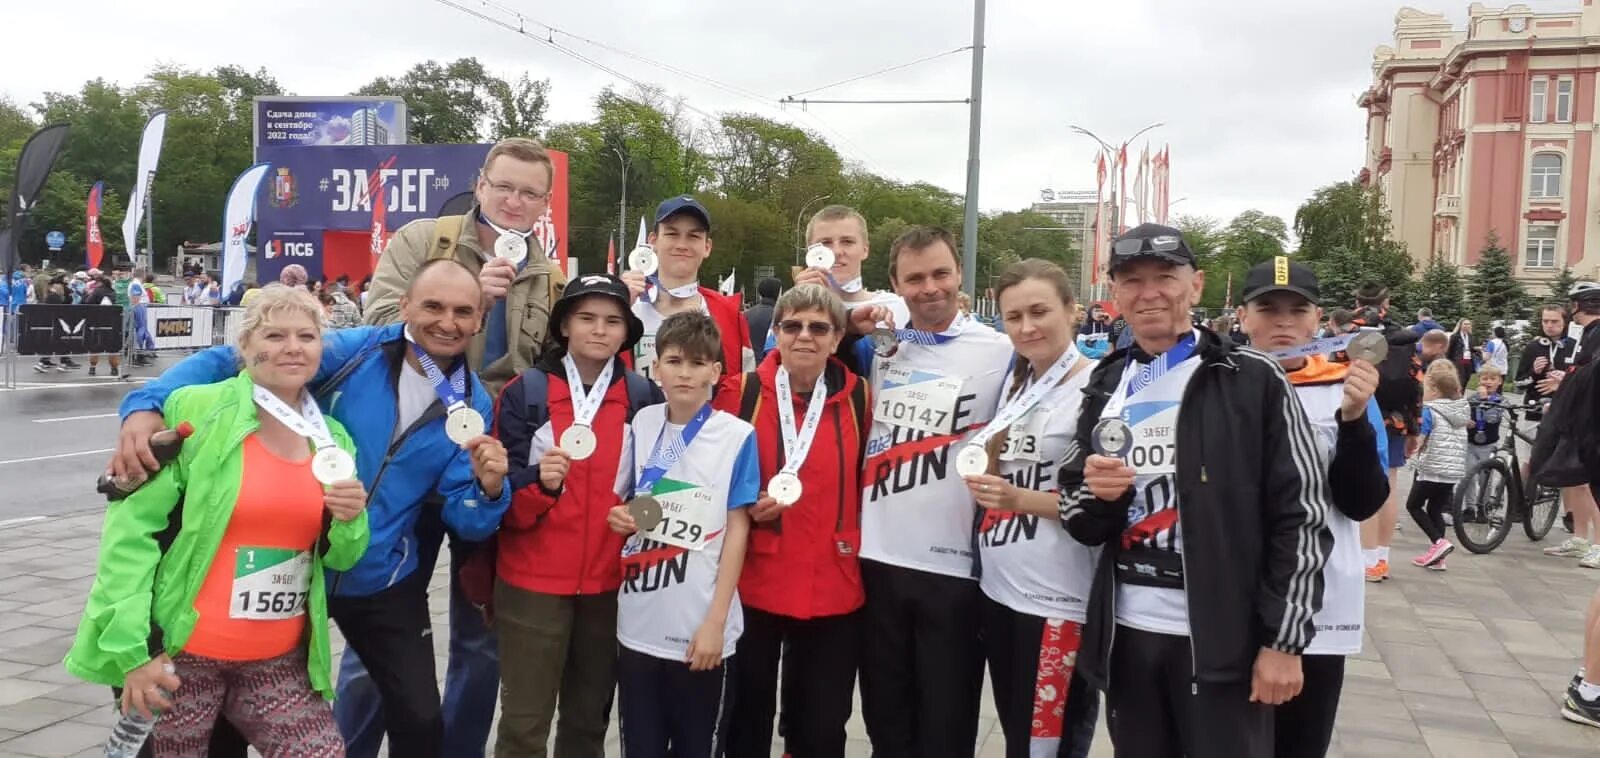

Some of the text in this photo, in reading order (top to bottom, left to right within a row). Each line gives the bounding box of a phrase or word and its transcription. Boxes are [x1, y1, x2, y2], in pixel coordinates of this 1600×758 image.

[267, 131, 287, 140] 2022
[285, 242, 314, 257] ПСБ
[882, 399, 948, 428] 10147
[870, 444, 950, 503] RUN
[645, 516, 703, 543] 129
[247, 550, 255, 562] 1
[623, 550, 689, 594] RUN
